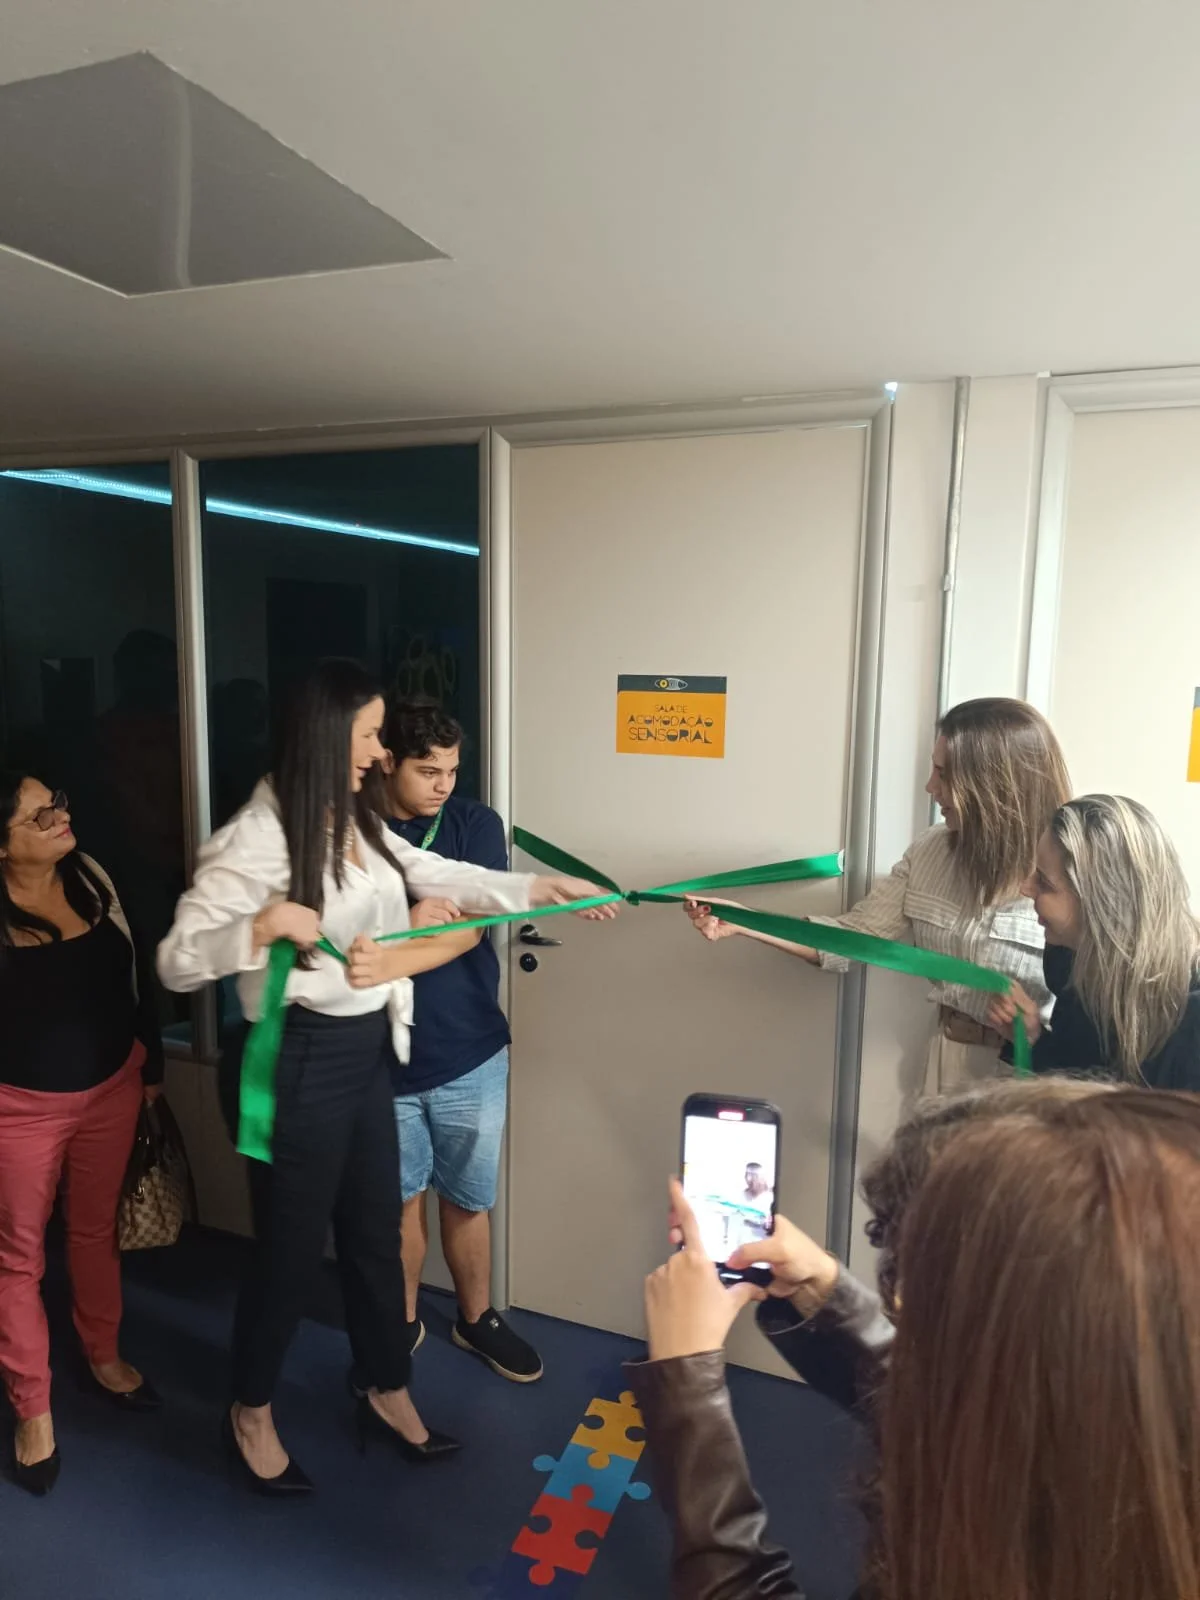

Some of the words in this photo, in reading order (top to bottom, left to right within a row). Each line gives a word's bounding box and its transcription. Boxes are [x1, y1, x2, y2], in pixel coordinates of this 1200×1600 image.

[655, 704, 675, 713] SALA
[676, 704, 688, 713] DE
[628, 727, 713, 744] SENSORIAL
